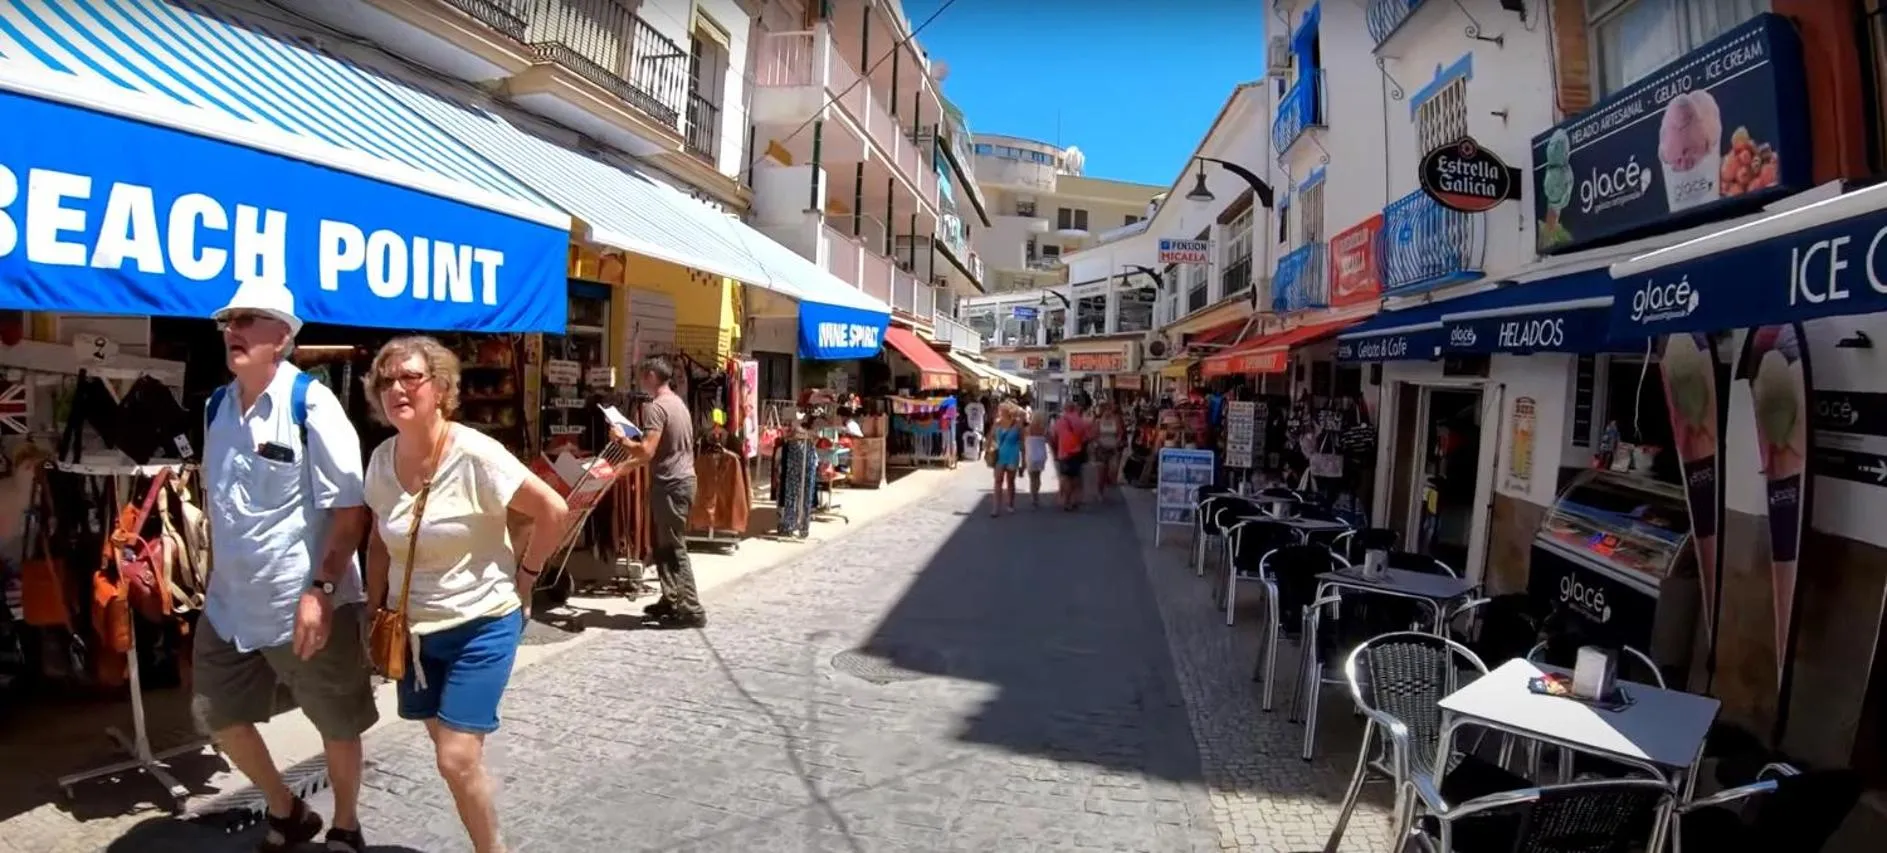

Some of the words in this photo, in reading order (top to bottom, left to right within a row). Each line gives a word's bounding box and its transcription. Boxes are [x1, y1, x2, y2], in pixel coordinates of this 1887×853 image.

[1571, 122, 1600, 145] HELADO
[1600, 101, 1644, 131] ARTESANAL
[1655, 75, 1692, 104] GELATO
[1705, 59, 1722, 80] ICE
[1723, 40, 1763, 70] CREAM
[1436, 155, 1499, 180] Estrella
[1440, 173, 1496, 197] Galicia
[1580, 154, 1640, 213] glacé
[319, 219, 504, 306] POINT
[1161, 252, 1206, 261] MICAELA
[1631, 274, 1691, 321] glacé
[1789, 236, 1850, 306] ICE
[1499, 319, 1564, 347] HELADOS
[1560, 572, 1604, 612] glacé
